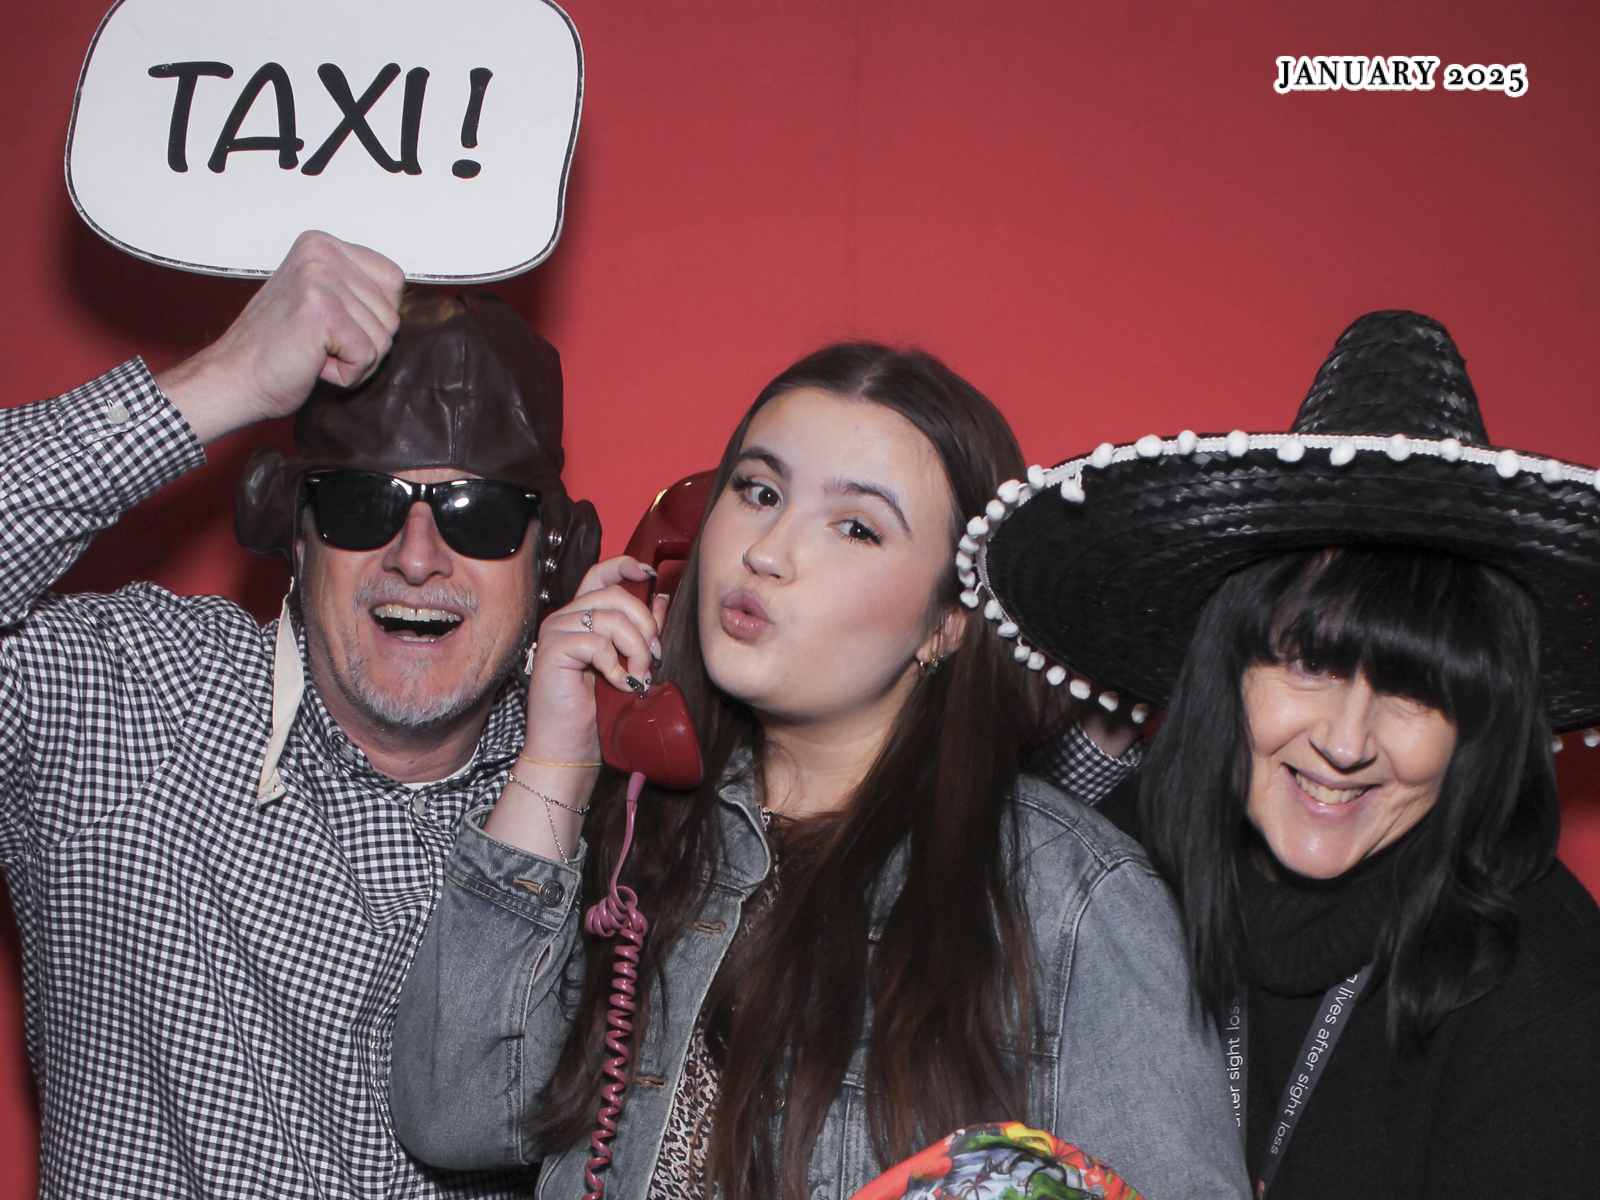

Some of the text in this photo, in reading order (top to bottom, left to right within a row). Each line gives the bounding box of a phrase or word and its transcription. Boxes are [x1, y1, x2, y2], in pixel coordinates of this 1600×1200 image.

[148, 61, 494, 179] TAXI!
[1226, 997, 1240, 1030] loss
[1324, 986, 1355, 1025] lives
[1226, 1037, 1244, 1080] sight
[1305, 1028, 1330, 1071] after
[1284, 1073, 1309, 1117] sight
[1270, 1121, 1291, 1155] loss
